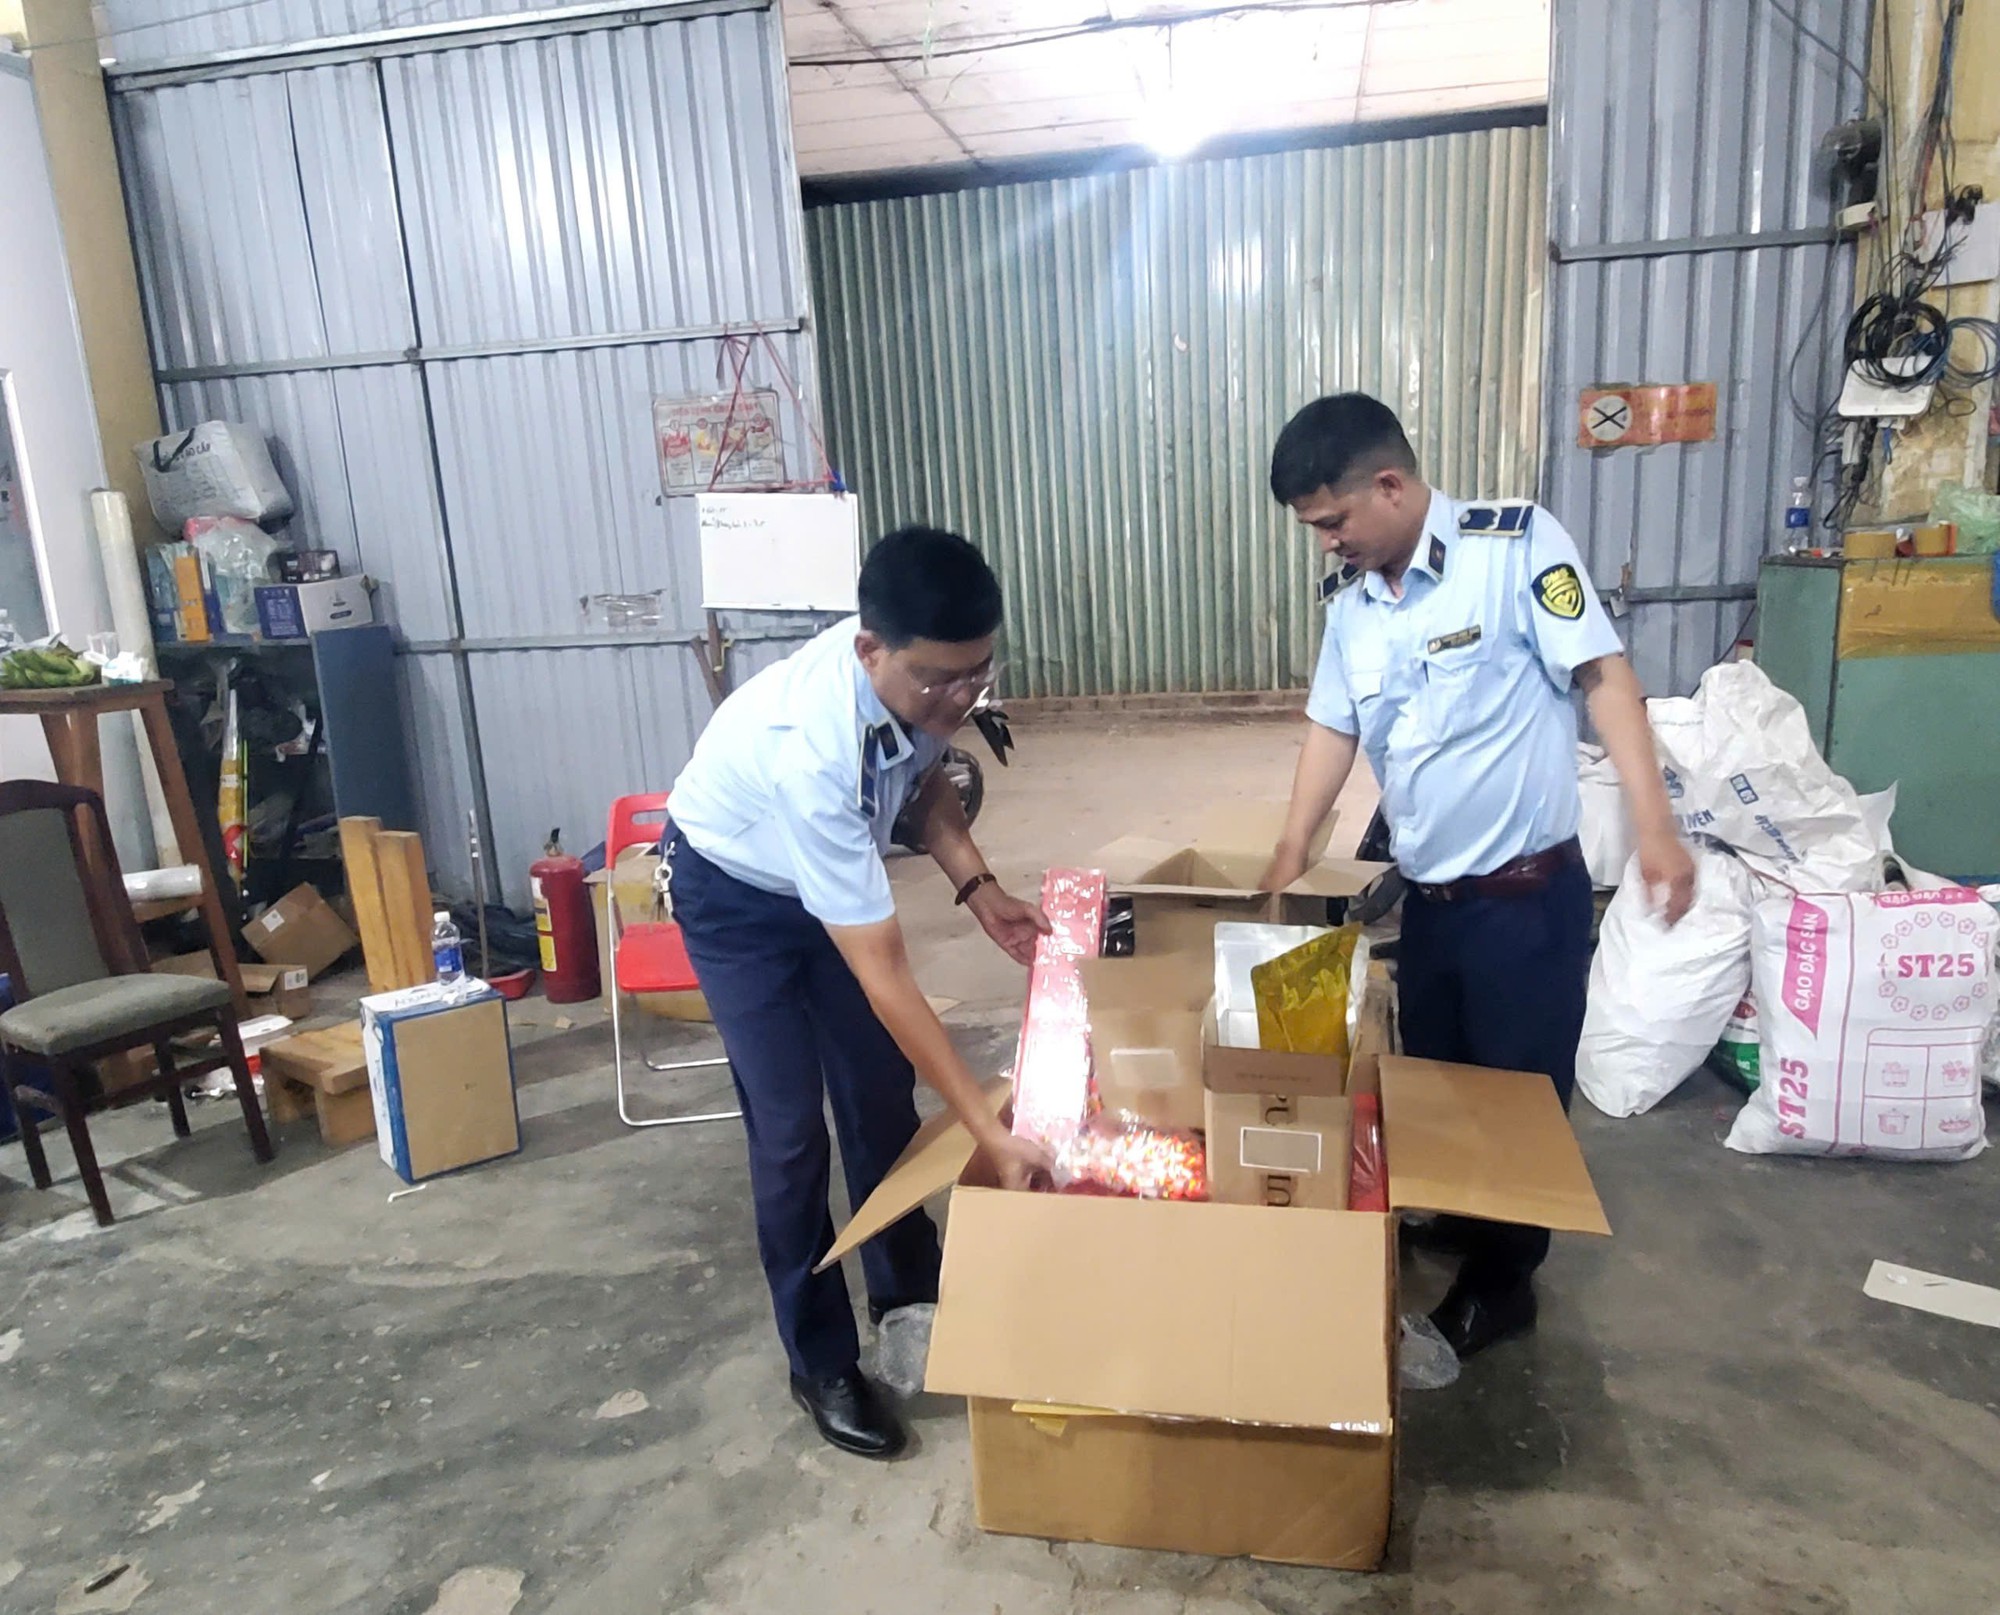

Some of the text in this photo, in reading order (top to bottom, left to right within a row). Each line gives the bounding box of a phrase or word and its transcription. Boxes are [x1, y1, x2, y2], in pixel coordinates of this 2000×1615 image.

[1897, 953, 1976, 978] ST25
[1793, 977, 1815, 1011] GẠO
[1778, 1058, 1809, 1140] ST25
